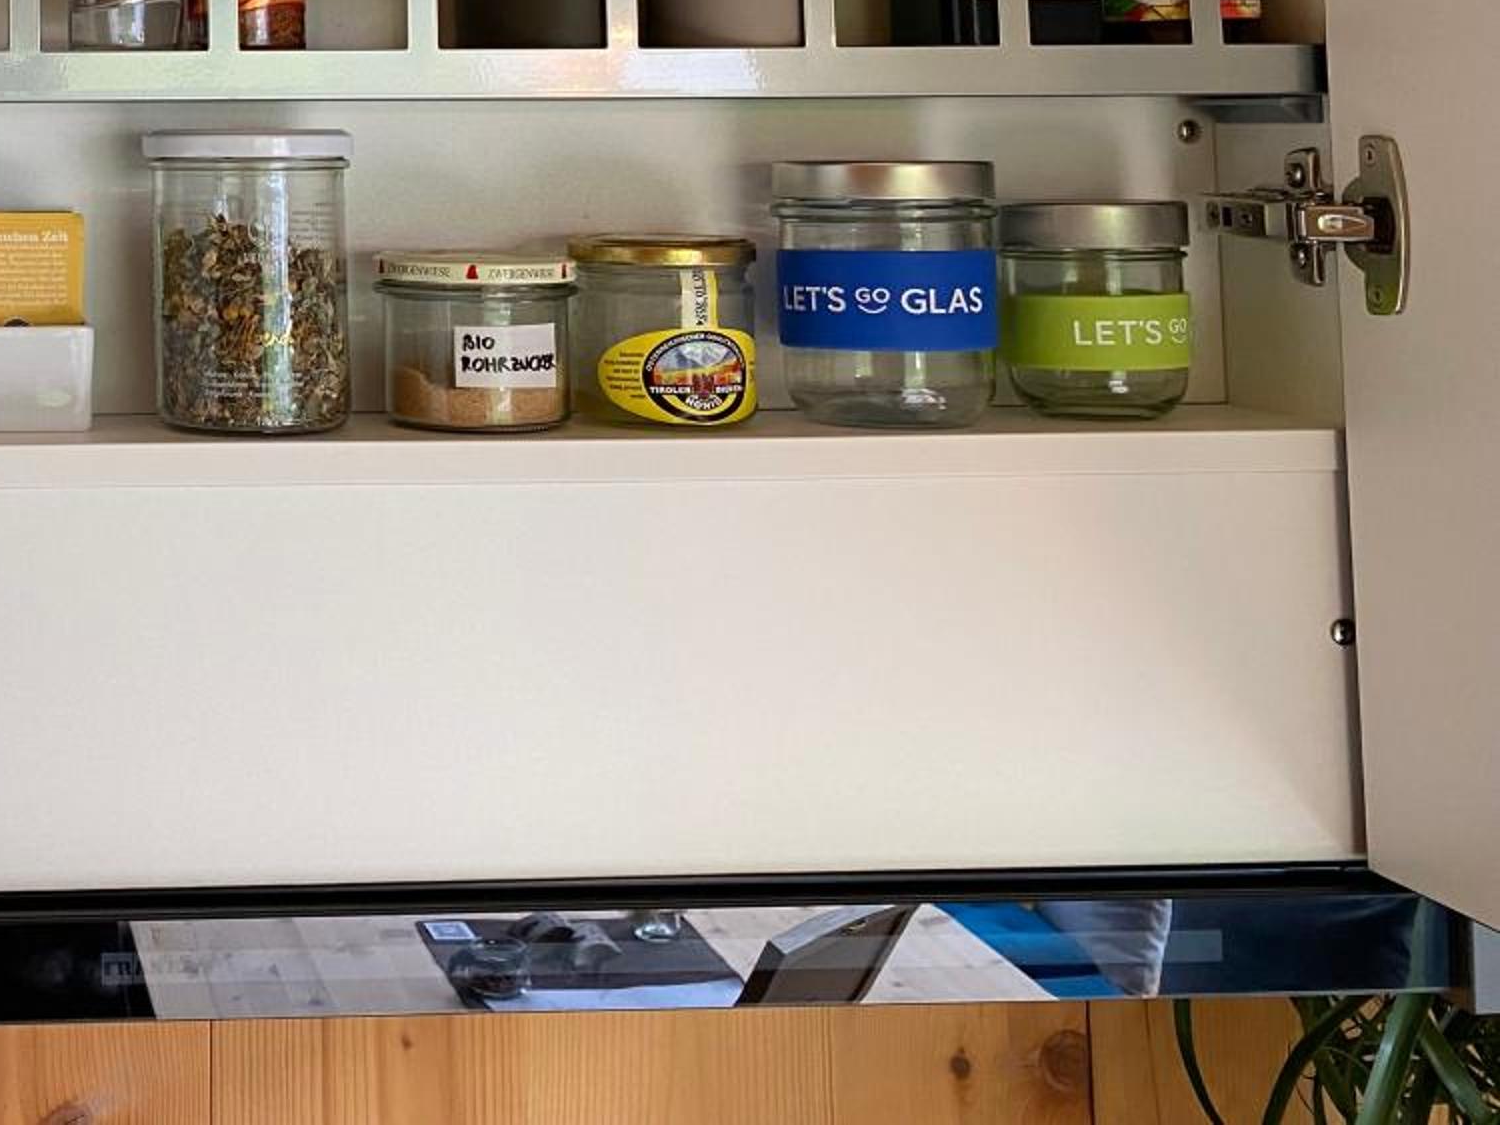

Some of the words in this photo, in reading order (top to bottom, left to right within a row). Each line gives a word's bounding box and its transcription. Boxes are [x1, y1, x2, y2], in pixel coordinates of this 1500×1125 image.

[783, 286, 846, 312] LET'S
[855, 287, 890, 304] GO
[901, 286, 983, 314] GLAS
[462, 334, 495, 351] BIO
[1073, 320, 1162, 346] LET'S
[1169, 319, 1187, 334] GO
